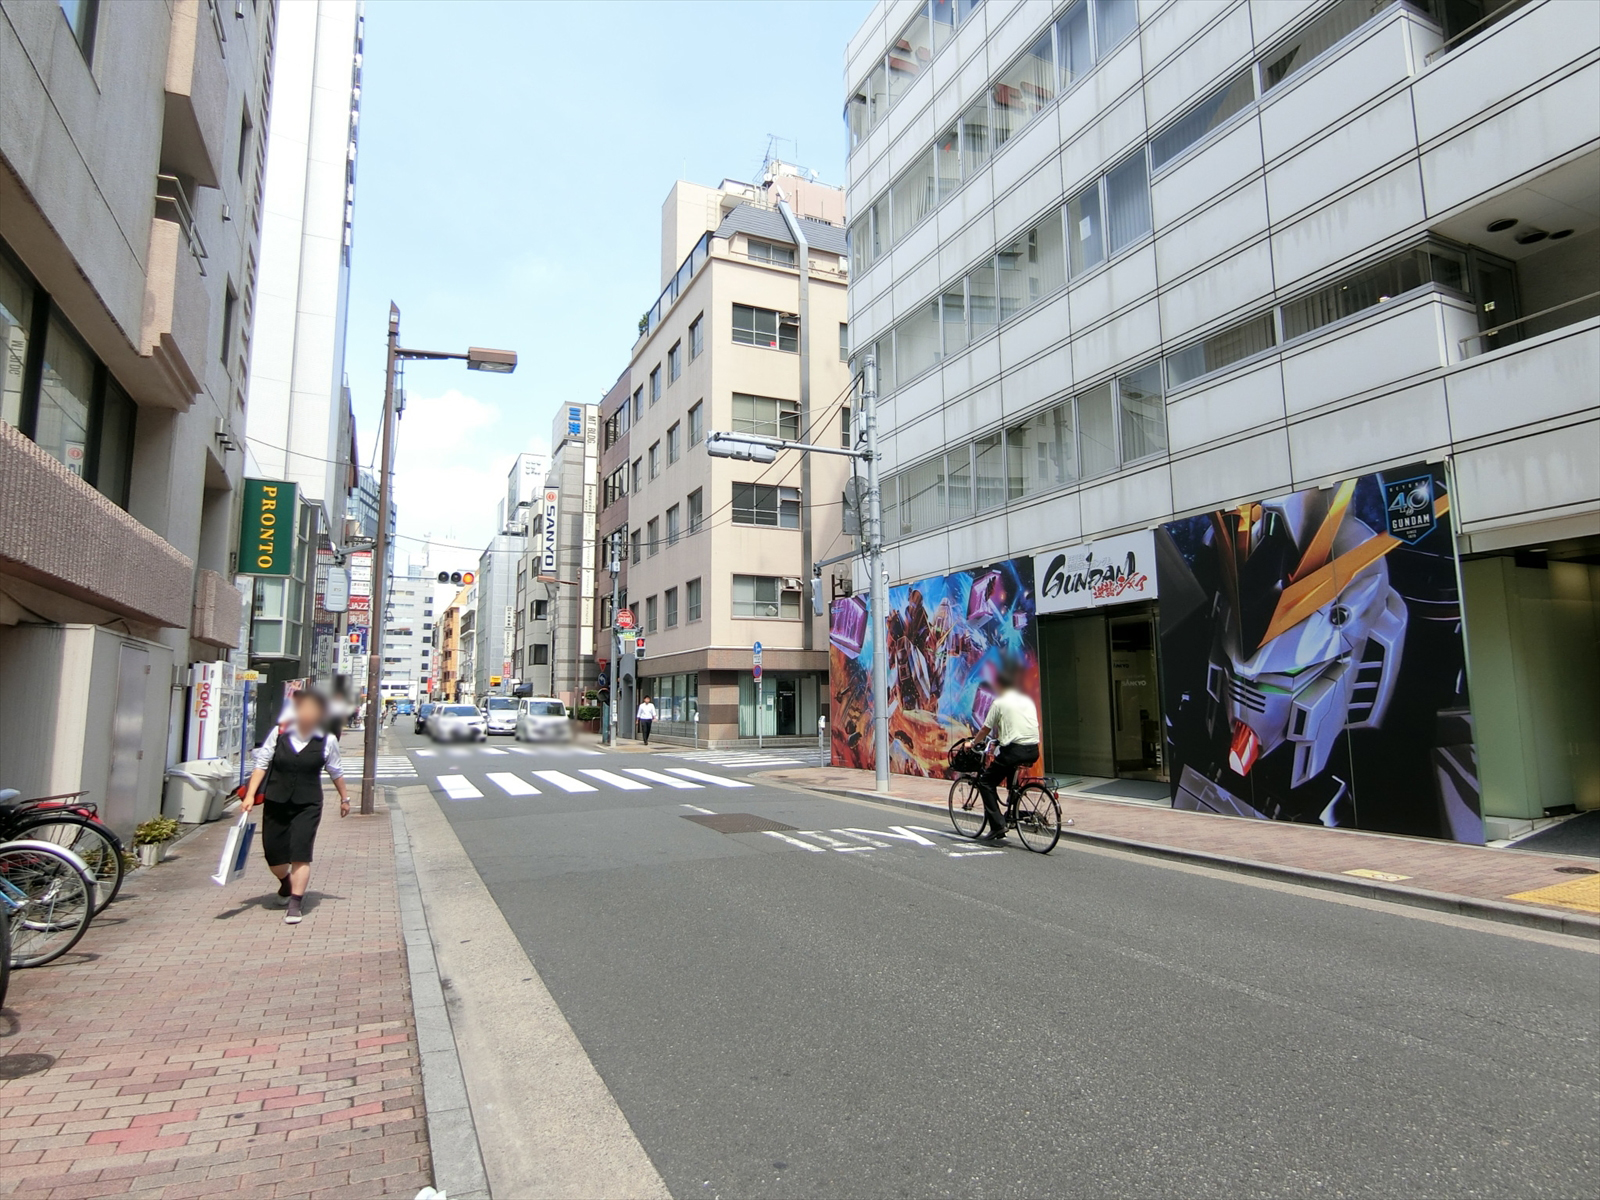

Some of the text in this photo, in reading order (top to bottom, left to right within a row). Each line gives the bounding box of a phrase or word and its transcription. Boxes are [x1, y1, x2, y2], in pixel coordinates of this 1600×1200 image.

[257, 485, 278, 569] PRONTO
[545, 505, 556, 567] SANYO
[1391, 513, 1431, 529] GUNDAM
[1042, 551, 1136, 598] GUNDAM
[348, 602, 369, 610] JAZZ
[198, 682, 212, 719] DyDo
